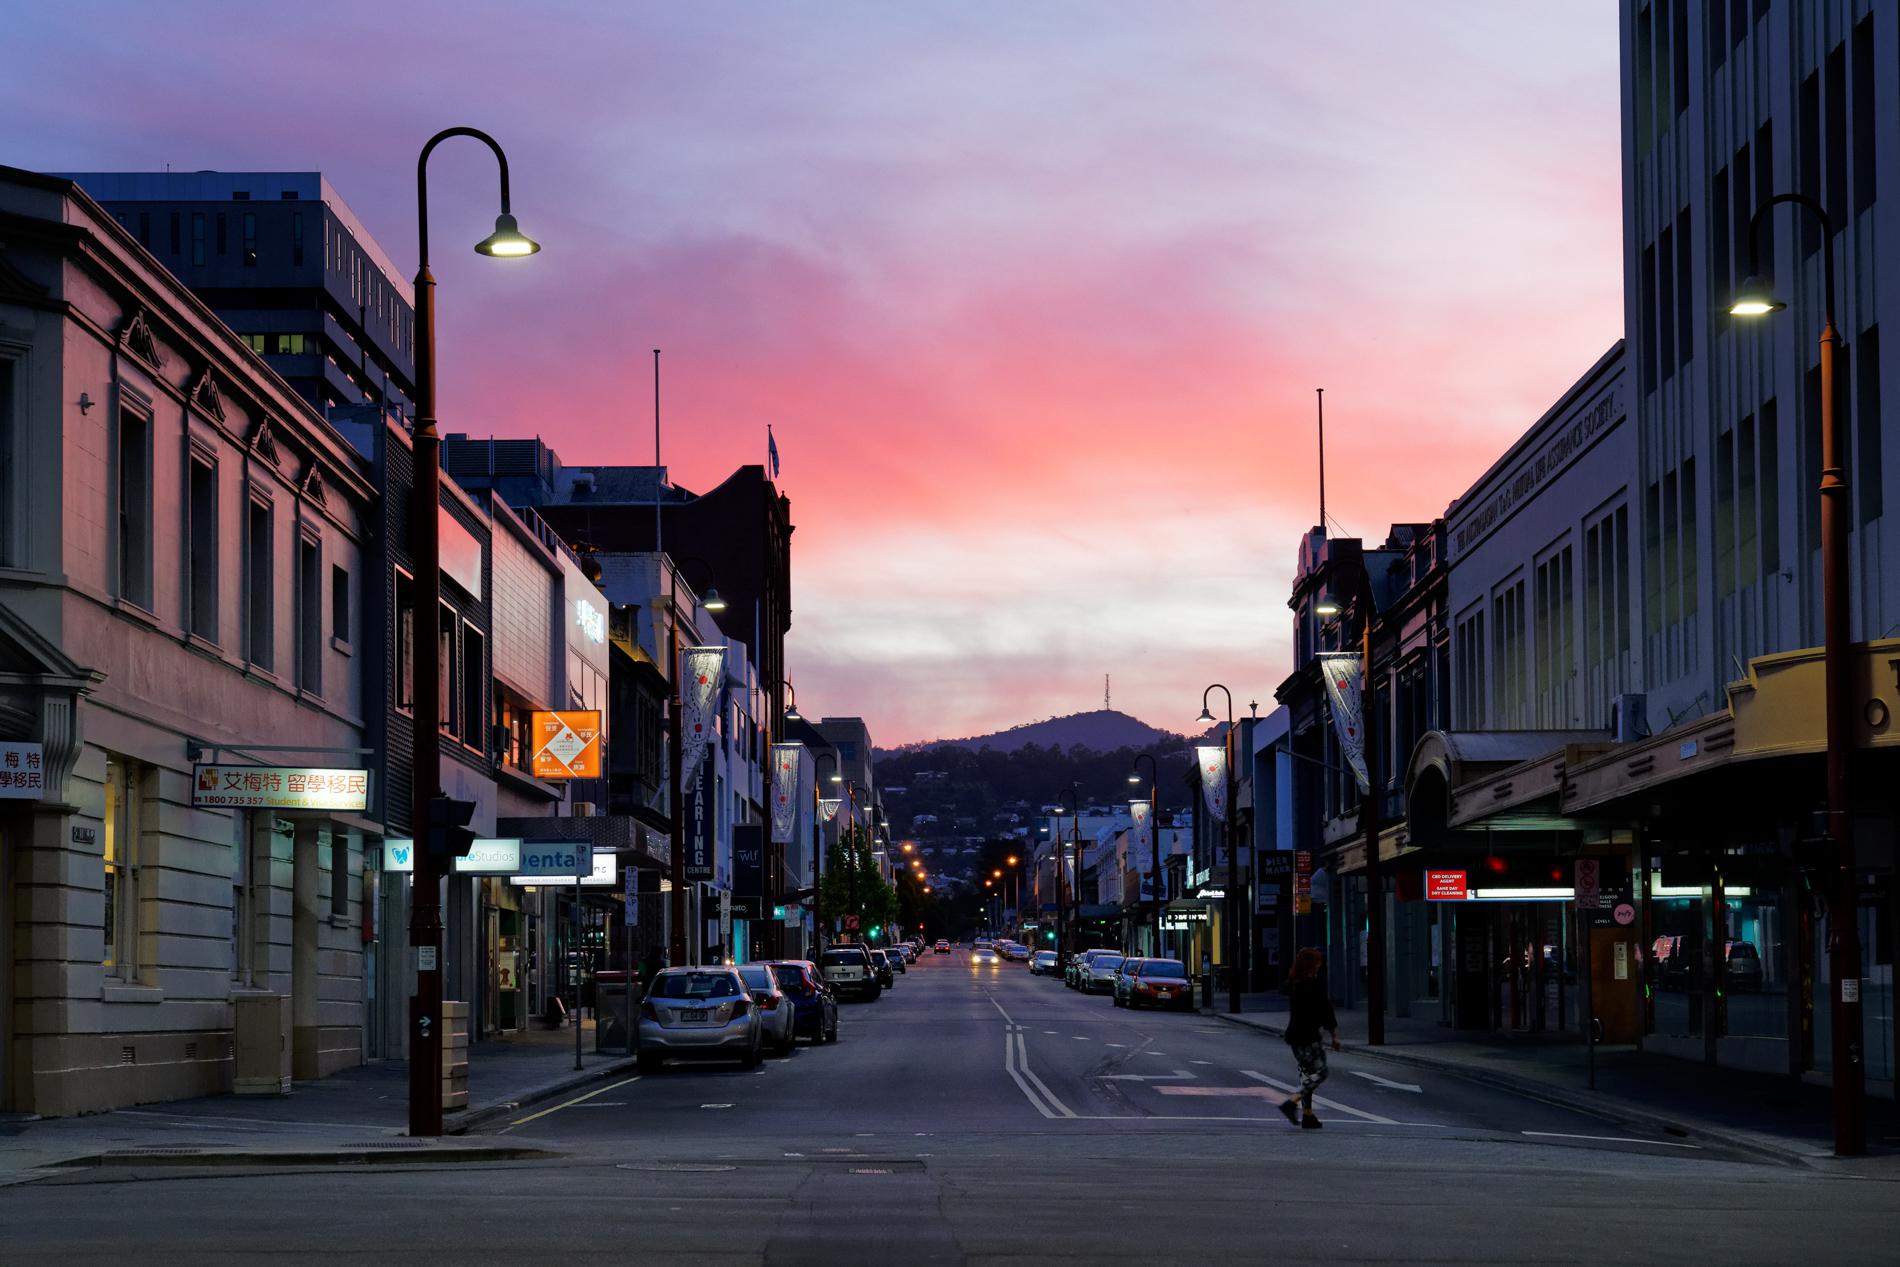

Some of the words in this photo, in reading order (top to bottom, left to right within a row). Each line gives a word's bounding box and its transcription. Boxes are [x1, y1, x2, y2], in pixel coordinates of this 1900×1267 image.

[223, 771, 282, 792] 艾梅特
[287, 773, 367, 795] 留學移民
[204, 795, 226, 804] 1800
[227, 796, 245, 805] 735
[246, 797, 264, 805] 357
